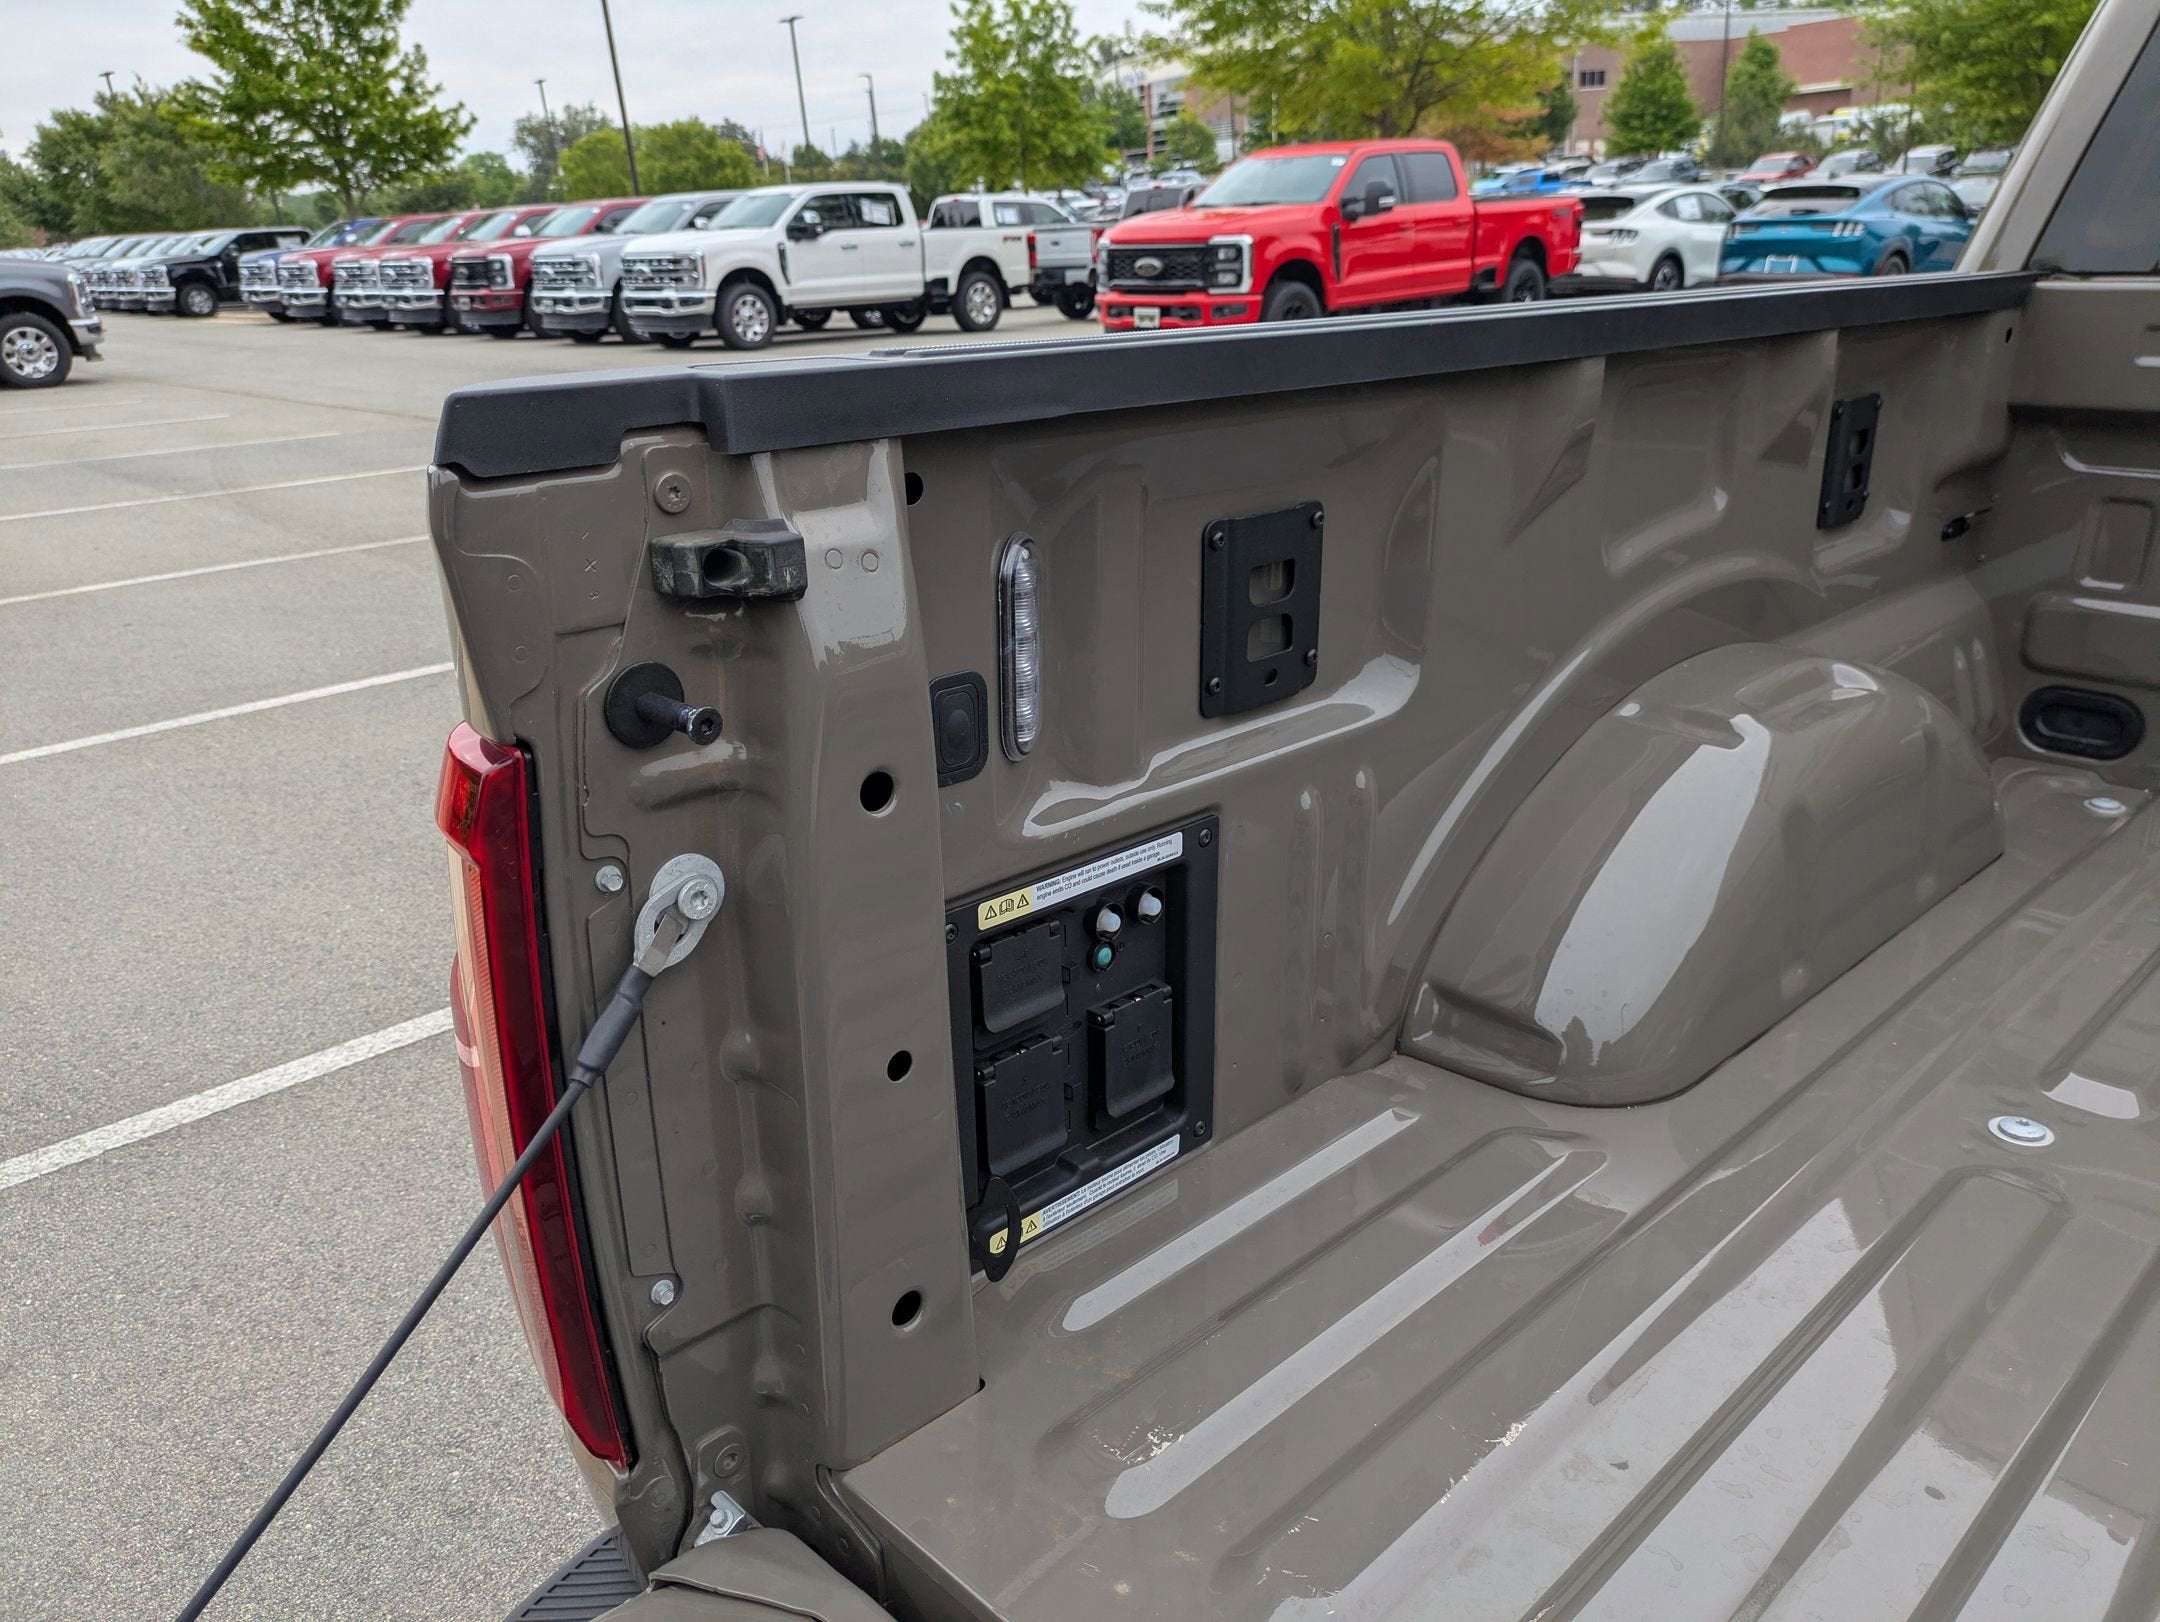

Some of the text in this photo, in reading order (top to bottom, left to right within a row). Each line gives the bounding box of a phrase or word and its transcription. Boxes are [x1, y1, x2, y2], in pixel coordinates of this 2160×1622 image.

[1036, 879, 1061, 893] WARNING:
[1062, 873, 1077, 883] Engine
[1097, 861, 1111, 871] power
[1125, 851, 1139, 860] outside
[1157, 838, 1172, 849] Running
[1037, 891, 1051, 902] engine
[1052, 886, 1063, 895] emits
[1065, 882, 1072, 891] CO
[1082, 875, 1092, 884] could
[1093, 871, 1106, 880] cause
[1106, 866, 1117, 875] death
[1121, 861, 1131, 869] used
[1132, 857, 1143, 865] inside
